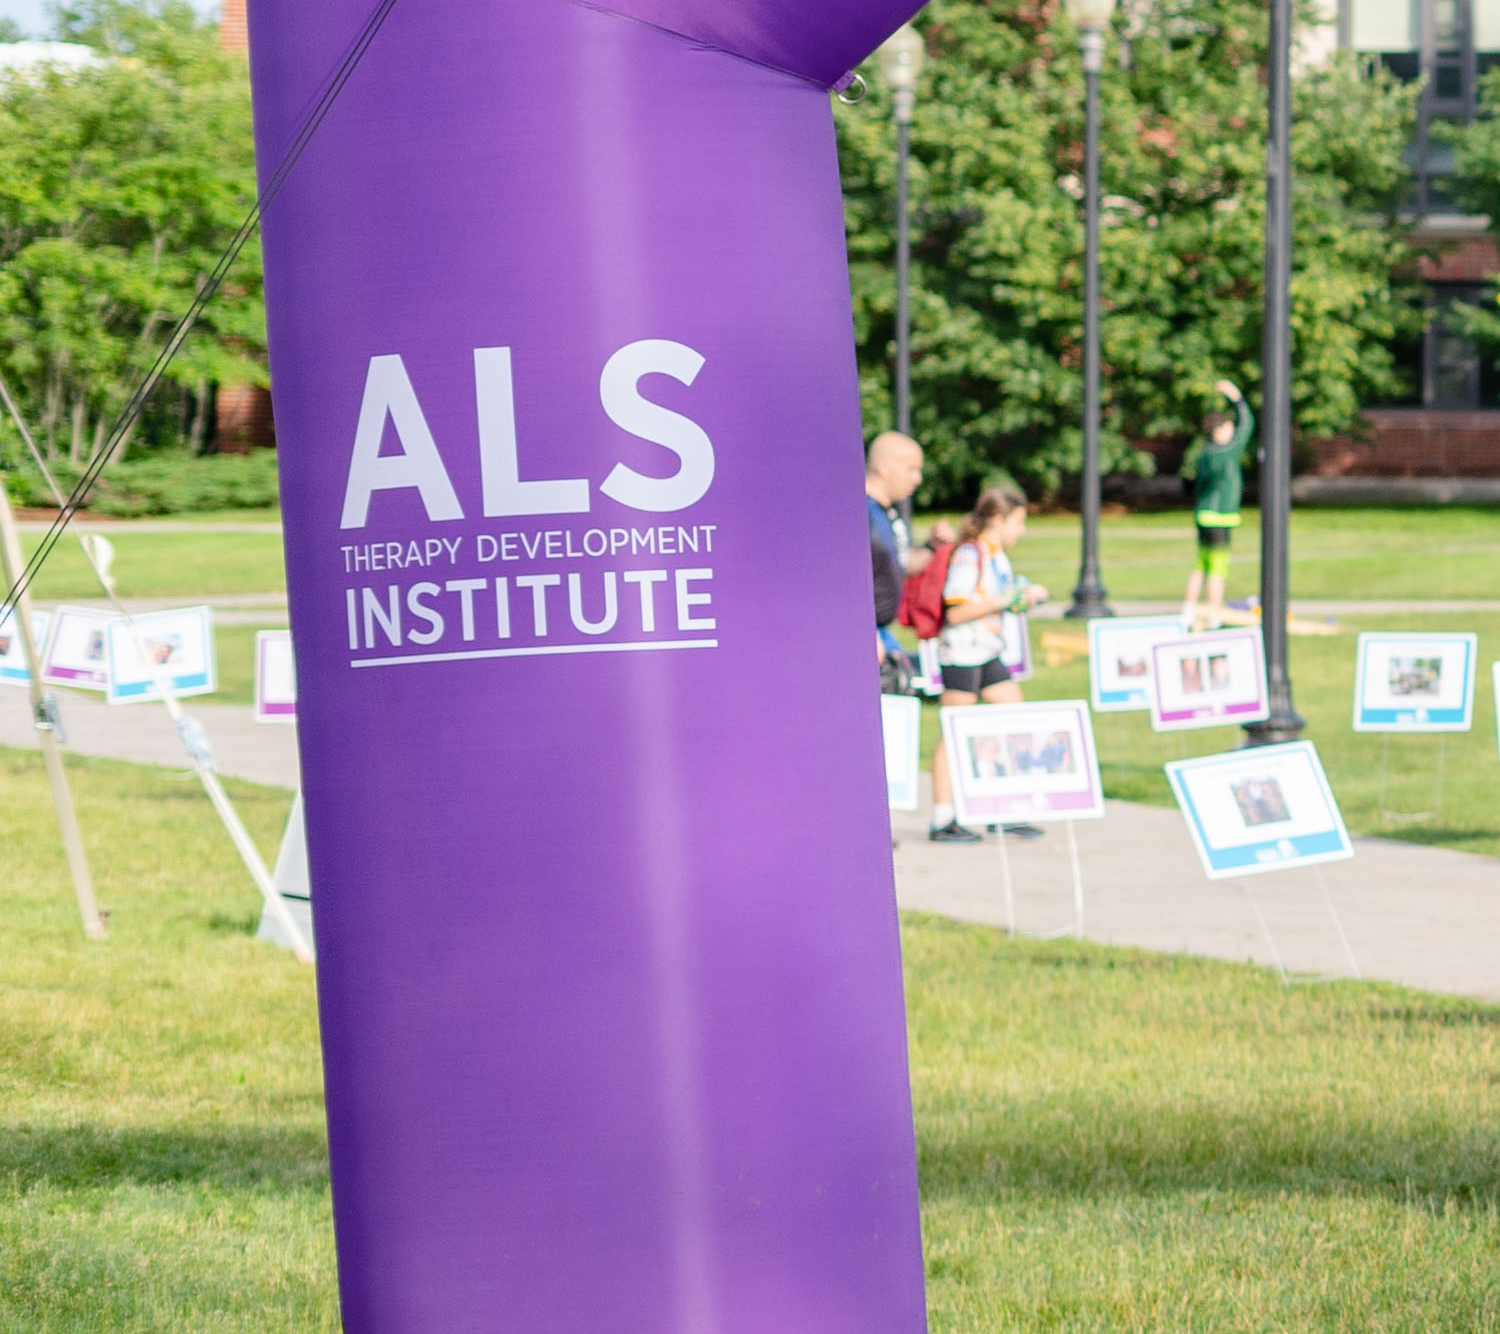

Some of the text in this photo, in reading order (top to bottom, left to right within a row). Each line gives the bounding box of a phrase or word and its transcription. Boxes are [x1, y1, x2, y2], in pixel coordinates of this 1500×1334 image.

[340, 339, 715, 529] ALS
[340, 525, 717, 573] THERAPY DEVELOPMENT
[346, 568, 717, 650] INSTITUTE
